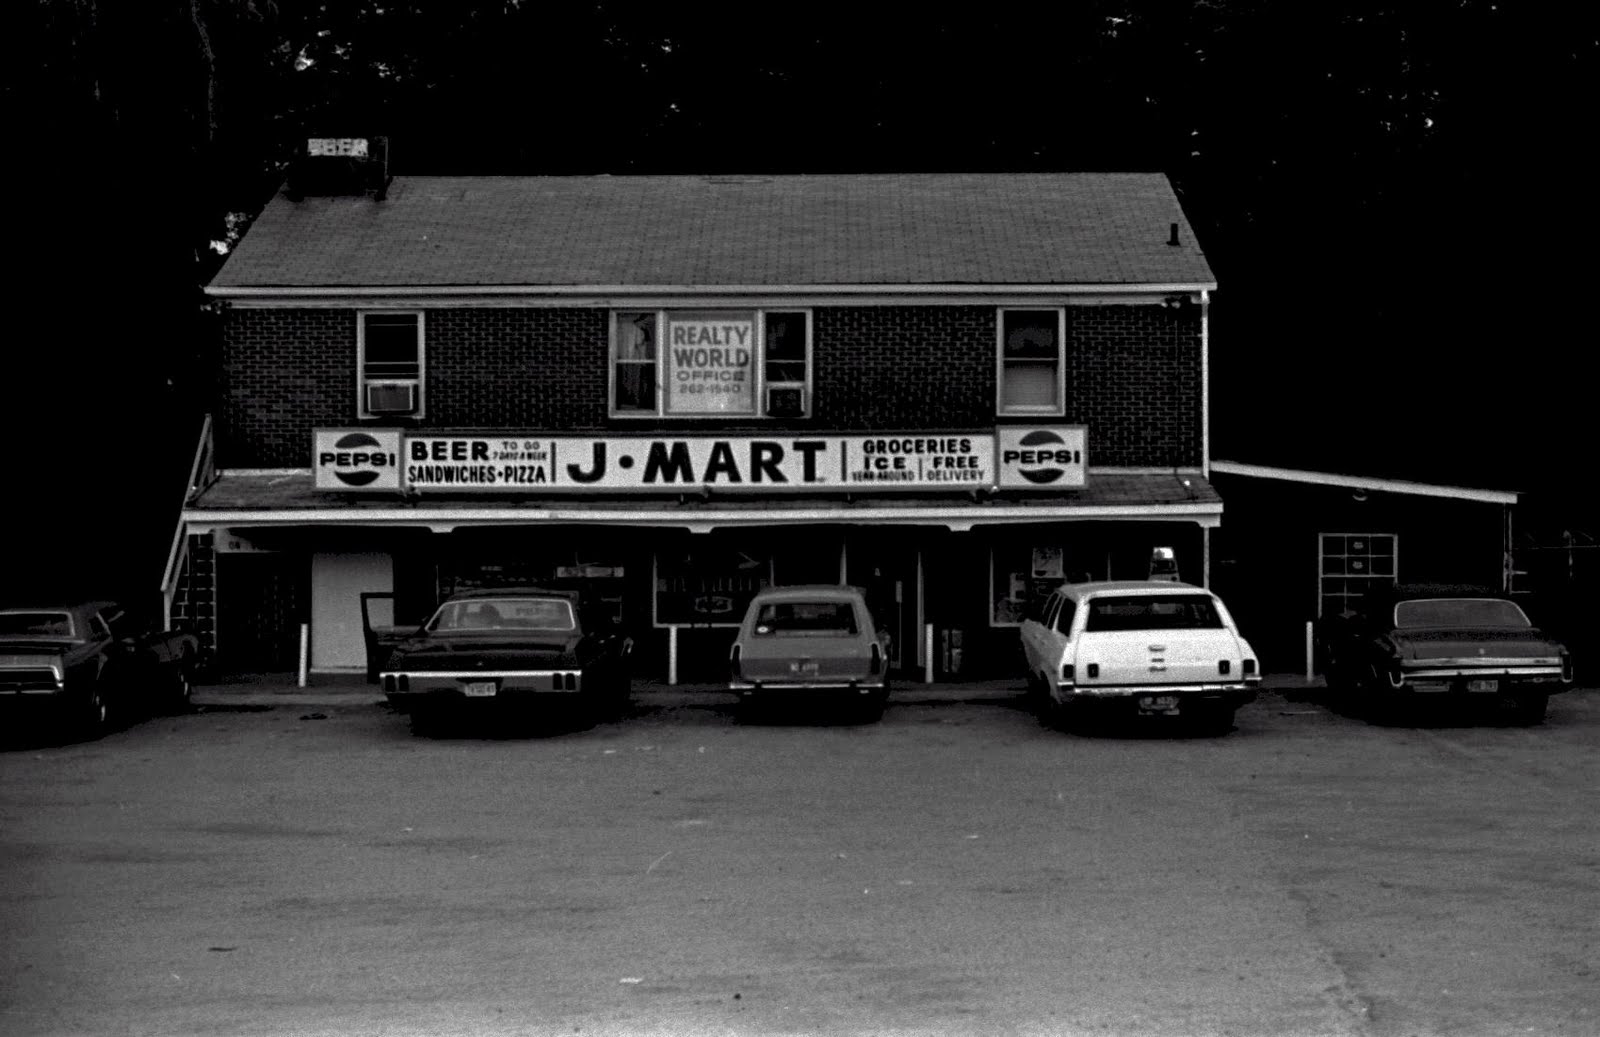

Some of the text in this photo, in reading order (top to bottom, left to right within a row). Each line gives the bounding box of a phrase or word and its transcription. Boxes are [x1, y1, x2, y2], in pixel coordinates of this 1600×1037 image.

[674, 326, 749, 345] REALTY
[674, 349, 749, 368] WORLD
[676, 370, 745, 381] OFFICE
[411, 441, 490, 461] BEER
[502, 440, 540, 451] TO GO
[863, 438, 972, 455] GROCERIES
[319, 452, 395, 467] PEPSI
[864, 455, 906, 470] ICE
[933, 455, 979, 470] FREE
[1004, 449, 1081, 464] PEPSI
[927, 470, 984, 482] DELIVERY
